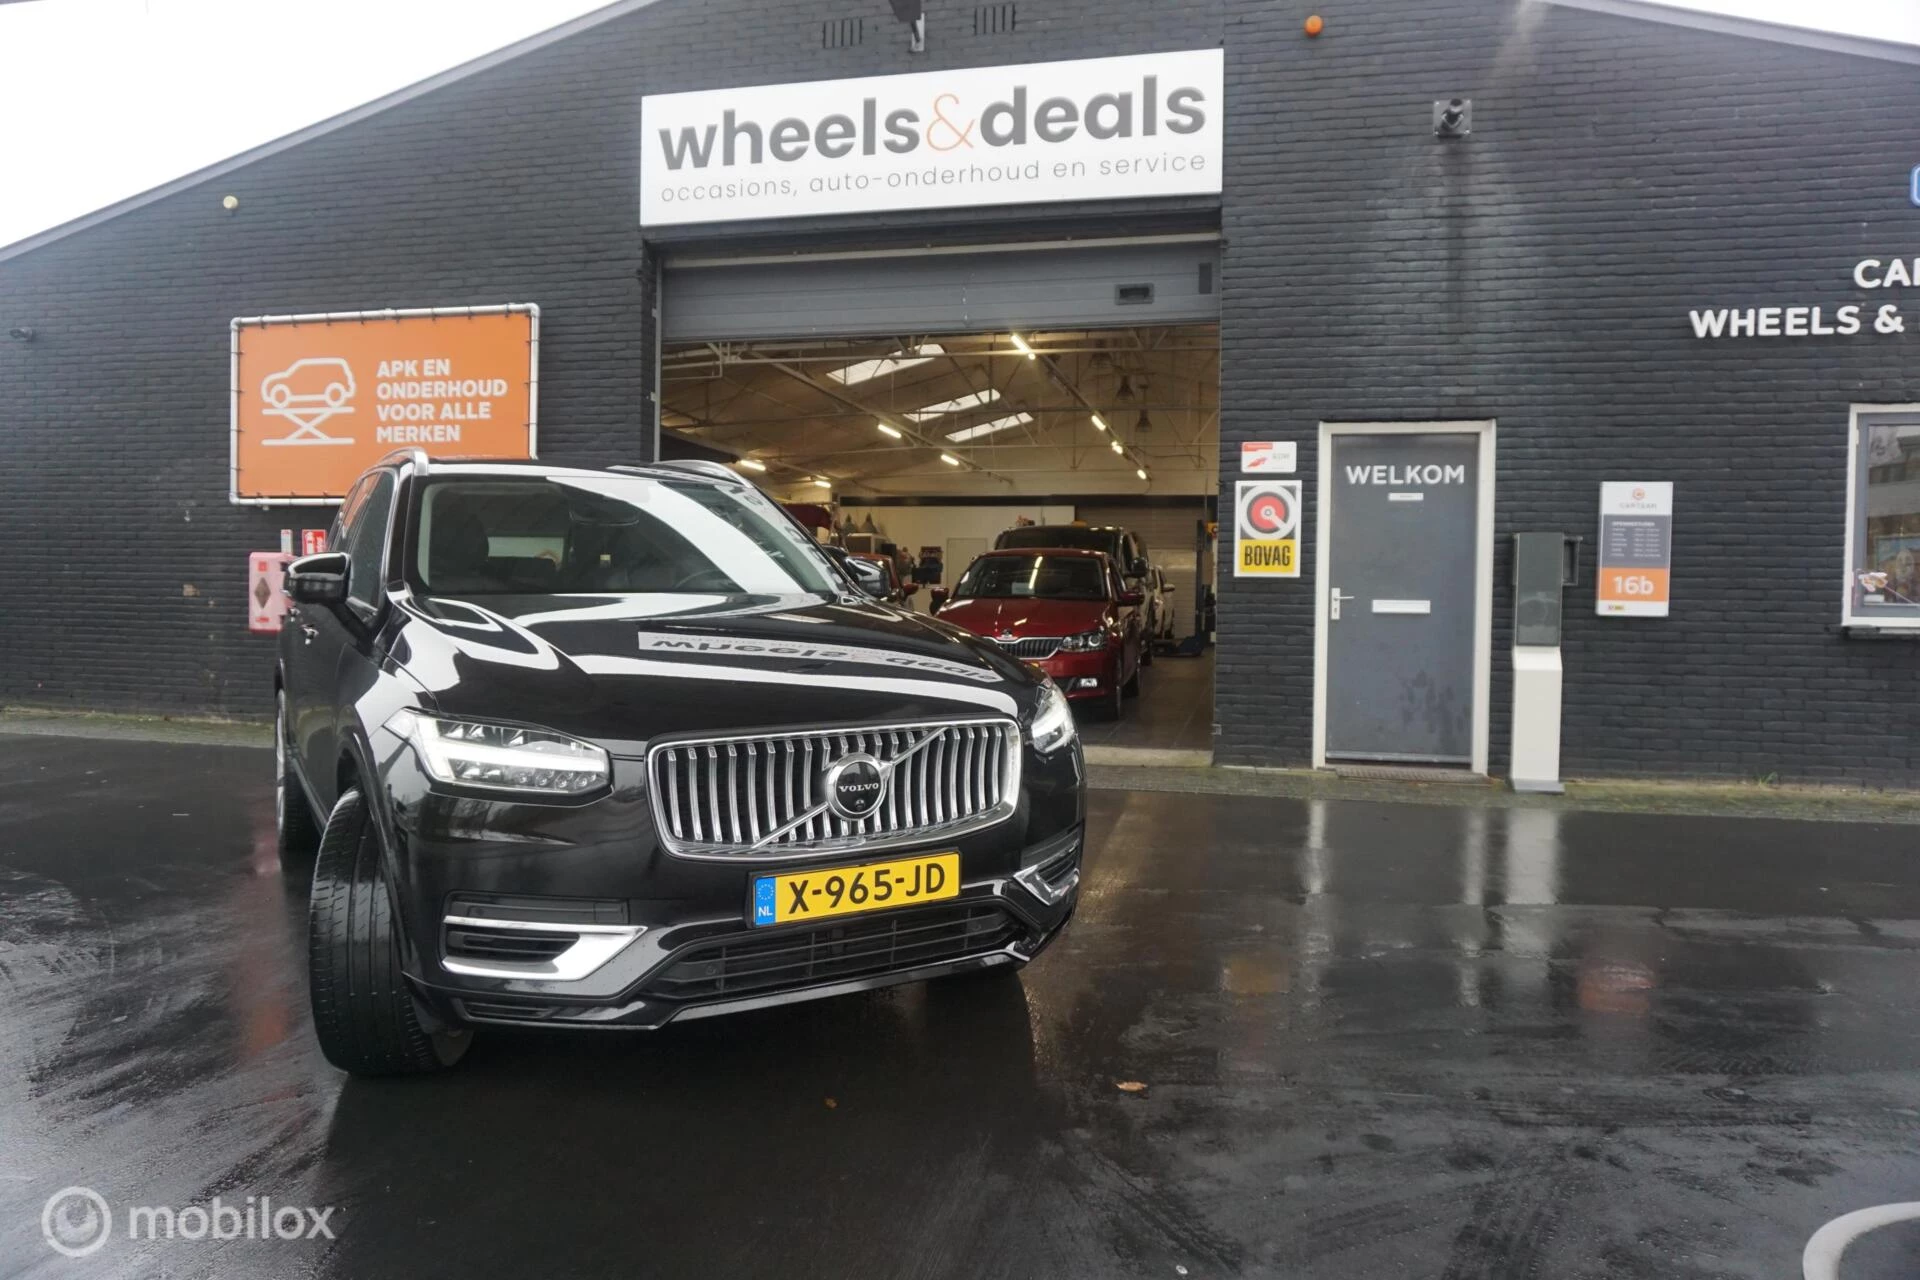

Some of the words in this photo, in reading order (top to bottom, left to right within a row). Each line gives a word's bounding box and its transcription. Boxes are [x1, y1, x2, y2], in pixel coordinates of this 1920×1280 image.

[658, 74, 1206, 170] wheels&deals
[661, 179, 798, 202] occasions,
[809, 160, 1040, 192] auto-onderhoud
[1053, 161, 1086, 178] en
[1099, 152, 1206, 176] service
[1853, 258, 1920, 288] CA
[1689, 305, 1861, 338] WHEELS
[1874, 304, 1905, 333] &
[376, 359, 419, 378] APK
[424, 358, 450, 376] EN
[376, 378, 508, 400] ONDERHOUD
[376, 402, 436, 421] VOOR
[440, 401, 491, 420] ALLE
[376, 424, 461, 443] MERKEN
[1346, 464, 1465, 485] WELKOM
[1244, 545, 1291, 567] BOVAG
[1613, 575, 1655, 596] 16b
[839, 782, 879, 793] VOLVO
[788, 862, 946, 914] X-965-JD
[758, 905, 773, 917] NL
